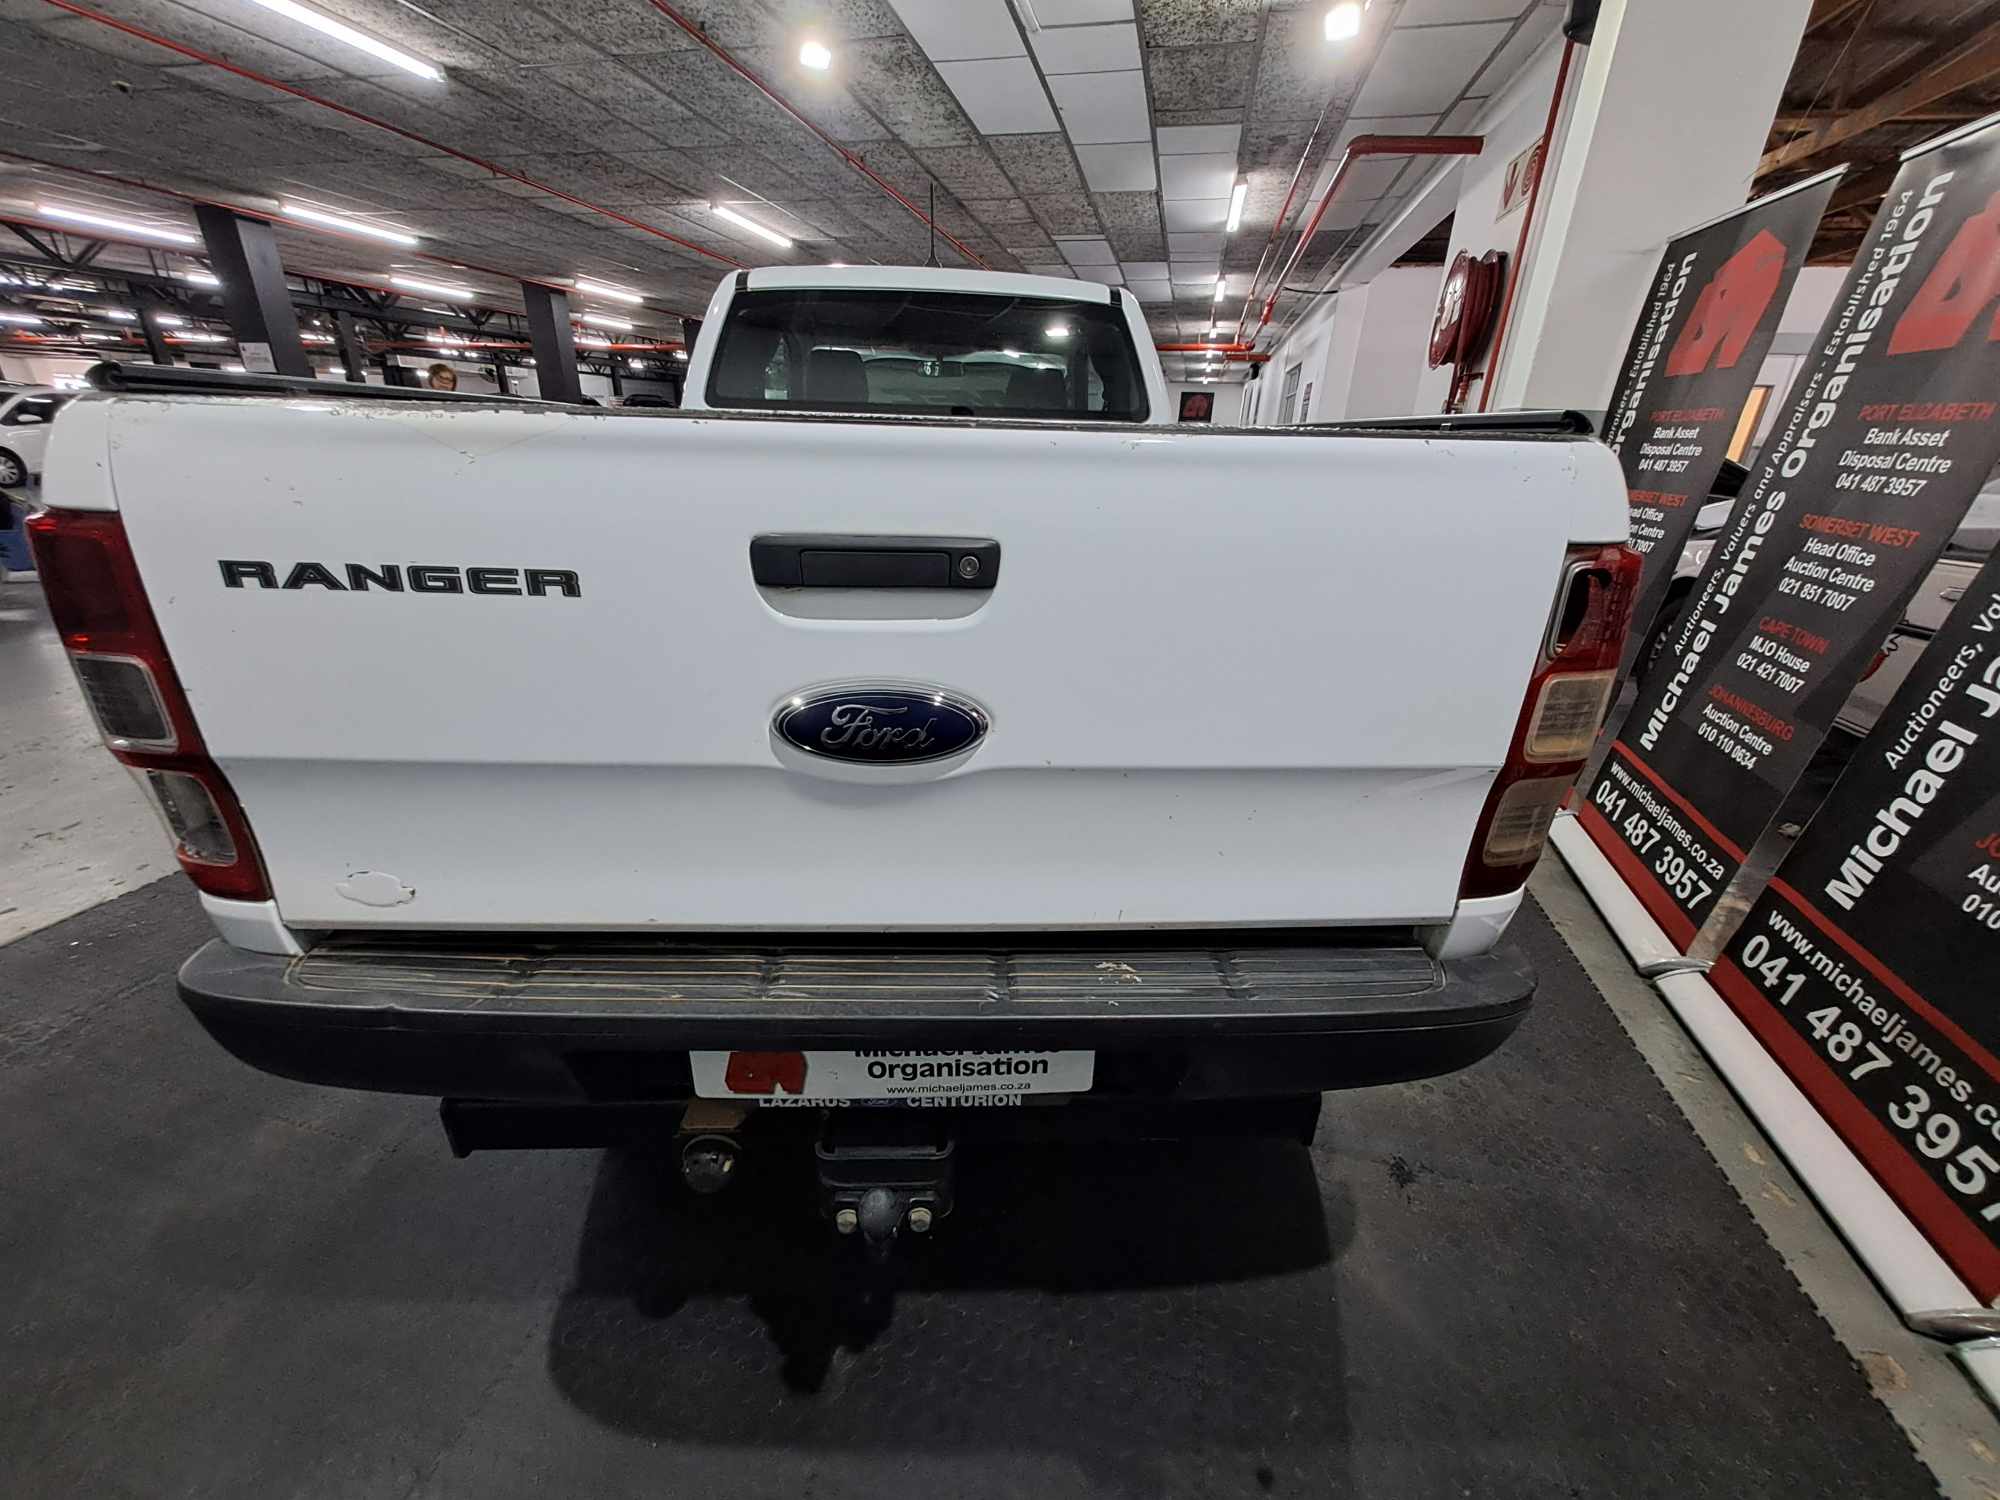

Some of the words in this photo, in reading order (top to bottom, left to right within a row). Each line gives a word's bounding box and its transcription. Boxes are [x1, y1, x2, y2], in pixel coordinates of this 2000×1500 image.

[1629, 302, 1662, 377] Established
[1658, 262, 1676, 297] 1964
[1674, 567, 1725, 656] Auctioneers,
[1720, 503, 1756, 561] Valuers
[1754, 466, 1776, 500] and
[1772, 372, 1823, 465] Appraisers
[1824, 247, 1886, 356] Established
[1880, 189, 1914, 242] 1964
[1858, 404, 1897, 421] PORT
[1898, 402, 1996, 421] ELIZABETH
[1640, 443, 1672, 456] Disposal
[1671, 444, 1703, 456] Centre
[1653, 427, 1674, 438] Bank
[1674, 427, 1700, 439] Asset
[1864, 428, 1901, 445] Bank
[1900, 428, 1951, 447] Asset
[1640, 619, 1717, 751] Michael
[1714, 490, 1786, 615] James
[1781, 171, 1955, 478] Organisation
[1838, 450, 1897, 471] Disposal
[1895, 453, 1952, 473] Centre
[1835, 473, 1862, 490] 041
[1860, 475, 1887, 492] 487
[1884, 478, 1927, 497] 3957
[1638, 523, 1665, 539] Centre
[1642, 508, 1664, 521] Office
[1800, 513, 1870, 538] SOMERSET
[1868, 523, 1920, 548] WEST
[1803, 537, 1839, 557] Head
[1837, 543, 1876, 566] Office
[218, 560, 581, 598] RANGER
[1783, 556, 1832, 580] Auction
[1829, 567, 1875, 592] Centre
[1779, 577, 1802, 595] 021
[1800, 583, 1823, 602] 851
[1821, 590, 1857, 611] 7007
[1760, 616, 1793, 638] CAPE
[1792, 627, 1831, 654] TOWN
[1749, 635, 1776, 656] MJO
[1774, 646, 1811, 673] House
[1736, 653, 1757, 672] 021
[1756, 662, 1777, 680] 421
[1774, 670, 1805, 694] 7007
[1885, 643, 1984, 770] Auctioneers,
[821, 704, 937, 750] Ford
[1702, 703, 1739, 734] Auction
[1738, 725, 1773, 755] Centre
[1698, 722, 1717, 742] 010
[1716, 733, 1734, 753] 110
[1731, 745, 1758, 770] 0634
[1610, 761, 1725, 880] www.michaeljames.co.za
[1825, 720, 1979, 911] Michael
[1596, 780, 1626, 822] 041
[1623, 812, 1661, 854] 487
[1655, 846, 1712, 909] 3957
[1742, 934, 1807, 1006] 041
[1805, 1006, 1893, 1081] 487
[867, 1057, 1049, 1081] Organisation
[886, 1080, 1031, 1095] www.michaeljames.co.za
[906, 1094, 1022, 1107] CENTURION
